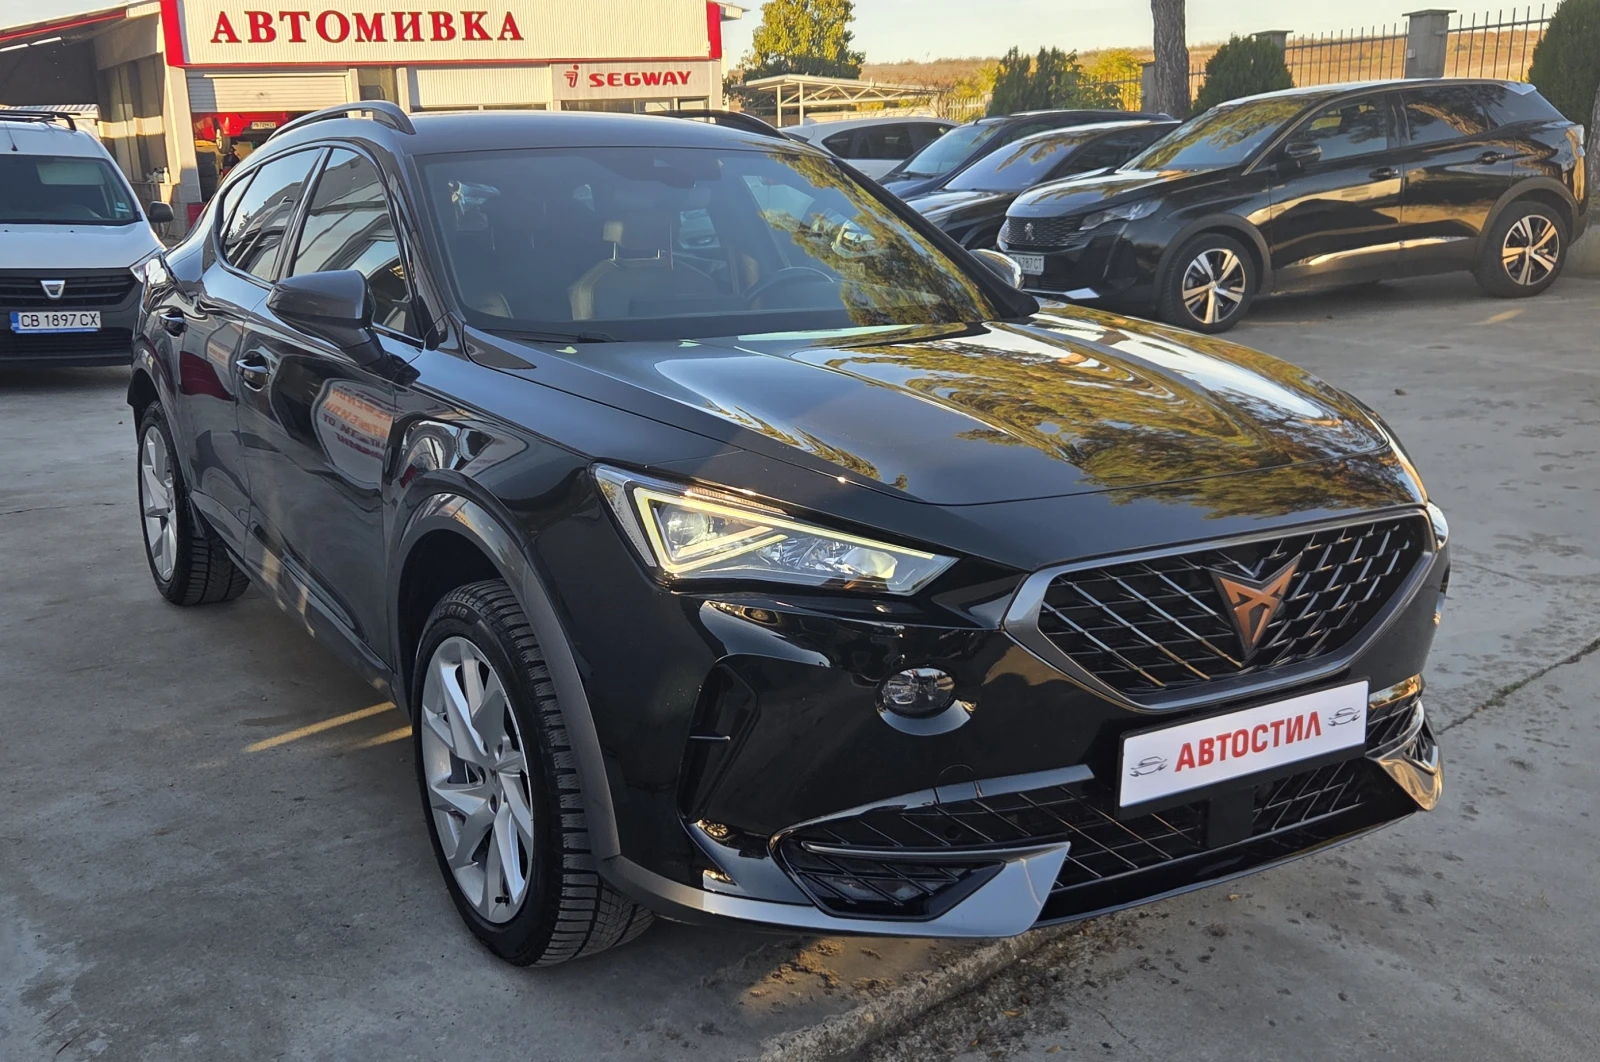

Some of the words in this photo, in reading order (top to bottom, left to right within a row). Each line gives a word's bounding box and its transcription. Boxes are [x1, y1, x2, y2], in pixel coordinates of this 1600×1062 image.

[210, 10, 525, 43] АВТОМИВКА
[589, 71, 692, 88] SEGWAY
[21, 314, 40, 327] CB
[45, 313, 77, 327] 1897
[80, 313, 98, 326] CX
[1174, 711, 1322, 773] АВТОСТИЛ
